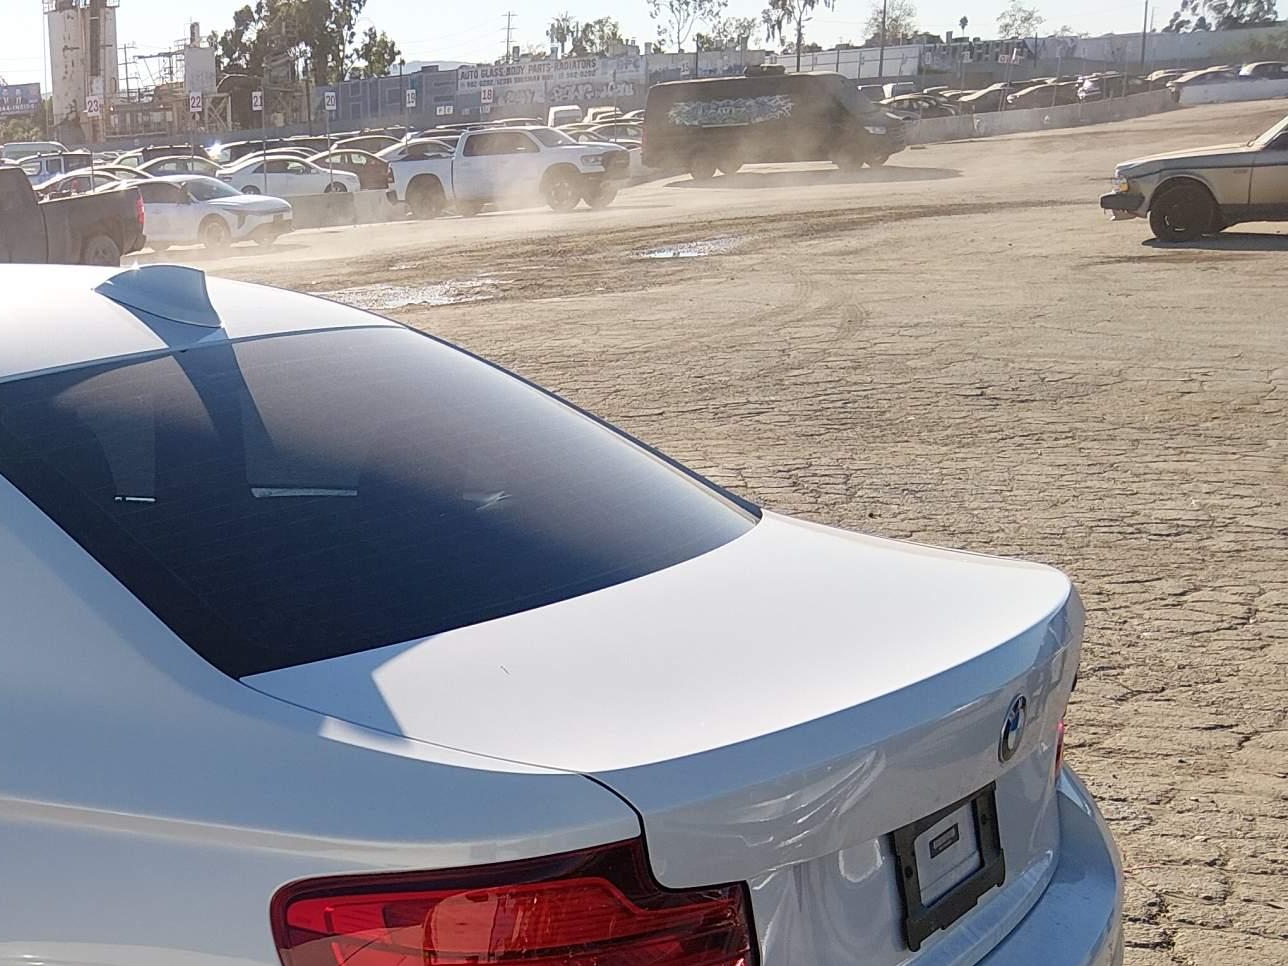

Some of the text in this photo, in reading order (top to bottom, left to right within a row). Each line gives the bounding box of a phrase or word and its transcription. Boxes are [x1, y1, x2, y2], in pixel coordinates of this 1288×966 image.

[460, 71, 479, 81] AUTO
[482, 89, 493, 100] 18
[87, 100, 99, 113] 23
[190, 96, 201, 108] 22
[253, 95, 263, 107] 21
[325, 95, 335, 107] 20
